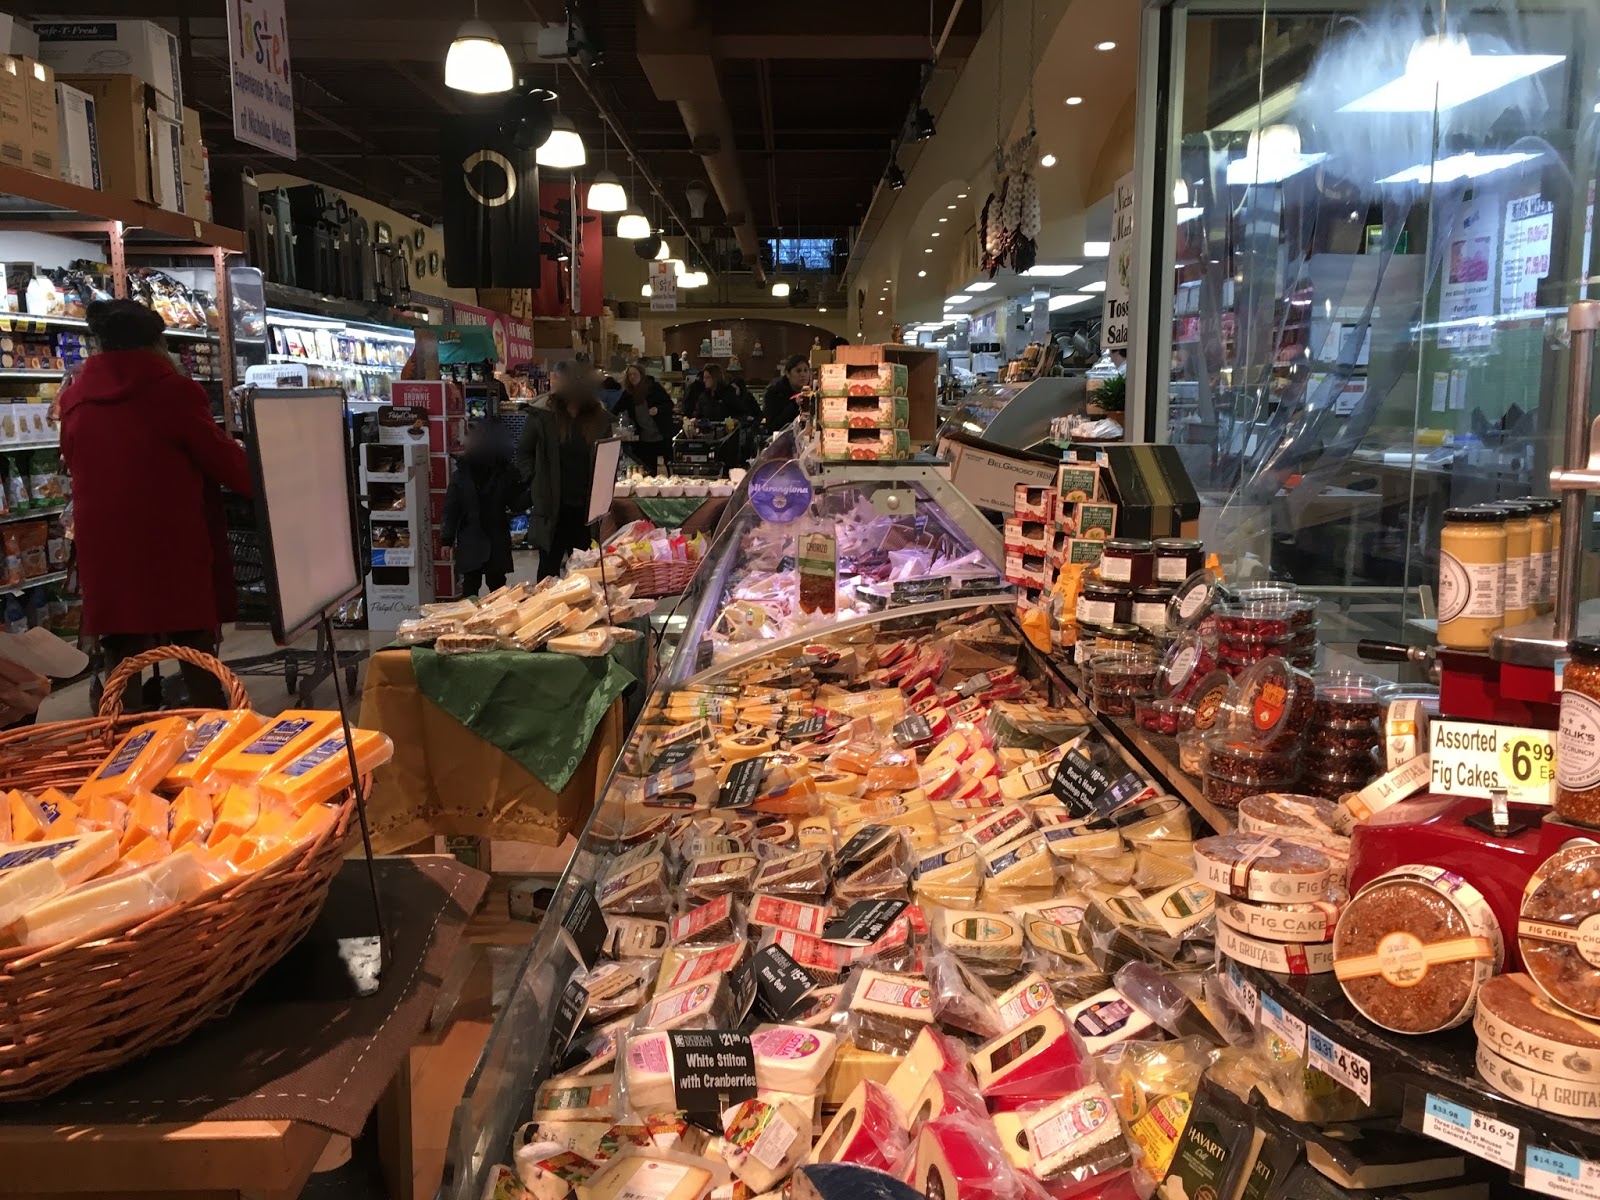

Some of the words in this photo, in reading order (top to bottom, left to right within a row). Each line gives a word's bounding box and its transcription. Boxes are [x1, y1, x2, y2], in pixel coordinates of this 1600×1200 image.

[403, 393, 430, 401] BROWNIE
[1436, 724, 1497, 753] Assorted
[1431, 760, 1453, 791] Fig
[1457, 761, 1499, 788] Cakes
[1540, 765, 1555, 780] Ea
[1377, 783, 1394, 798] LA
[1209, 866, 1219, 881] LA
[1297, 881, 1319, 894] FIG
[1250, 914, 1277, 928] FIG
[1283, 917, 1327, 931] CAKE
[1528, 925, 1543, 934] FIG
[1545, 928, 1569, 939] CAKE
[1227, 934, 1237, 949] LA
[1239, 942, 1269, 963] GRUTA
[1313, 952, 1334, 965] FIG
[1479, 1013, 1497, 1037] FIG
[1500, 1031, 1555, 1064] CAKE
[686, 1053, 714, 1068] White
[717, 1054, 747, 1067] Stilton
[680, 1074, 701, 1089] with
[703, 1072, 757, 1088] Cranberries
[1531, 1077, 1549, 1101] LA
[1554, 1086, 1598, 1108] GRUTA
[1433, 1117, 1451, 1128] Three
[1450, 1123, 1466, 1133] Little
[1465, 1128, 1479, 1141] Pigs
[1473, 1117, 1515, 1141] $16.99
[1187, 1126, 1227, 1162] HAVARTI
[1254, 1160, 1271, 1181] RTI
